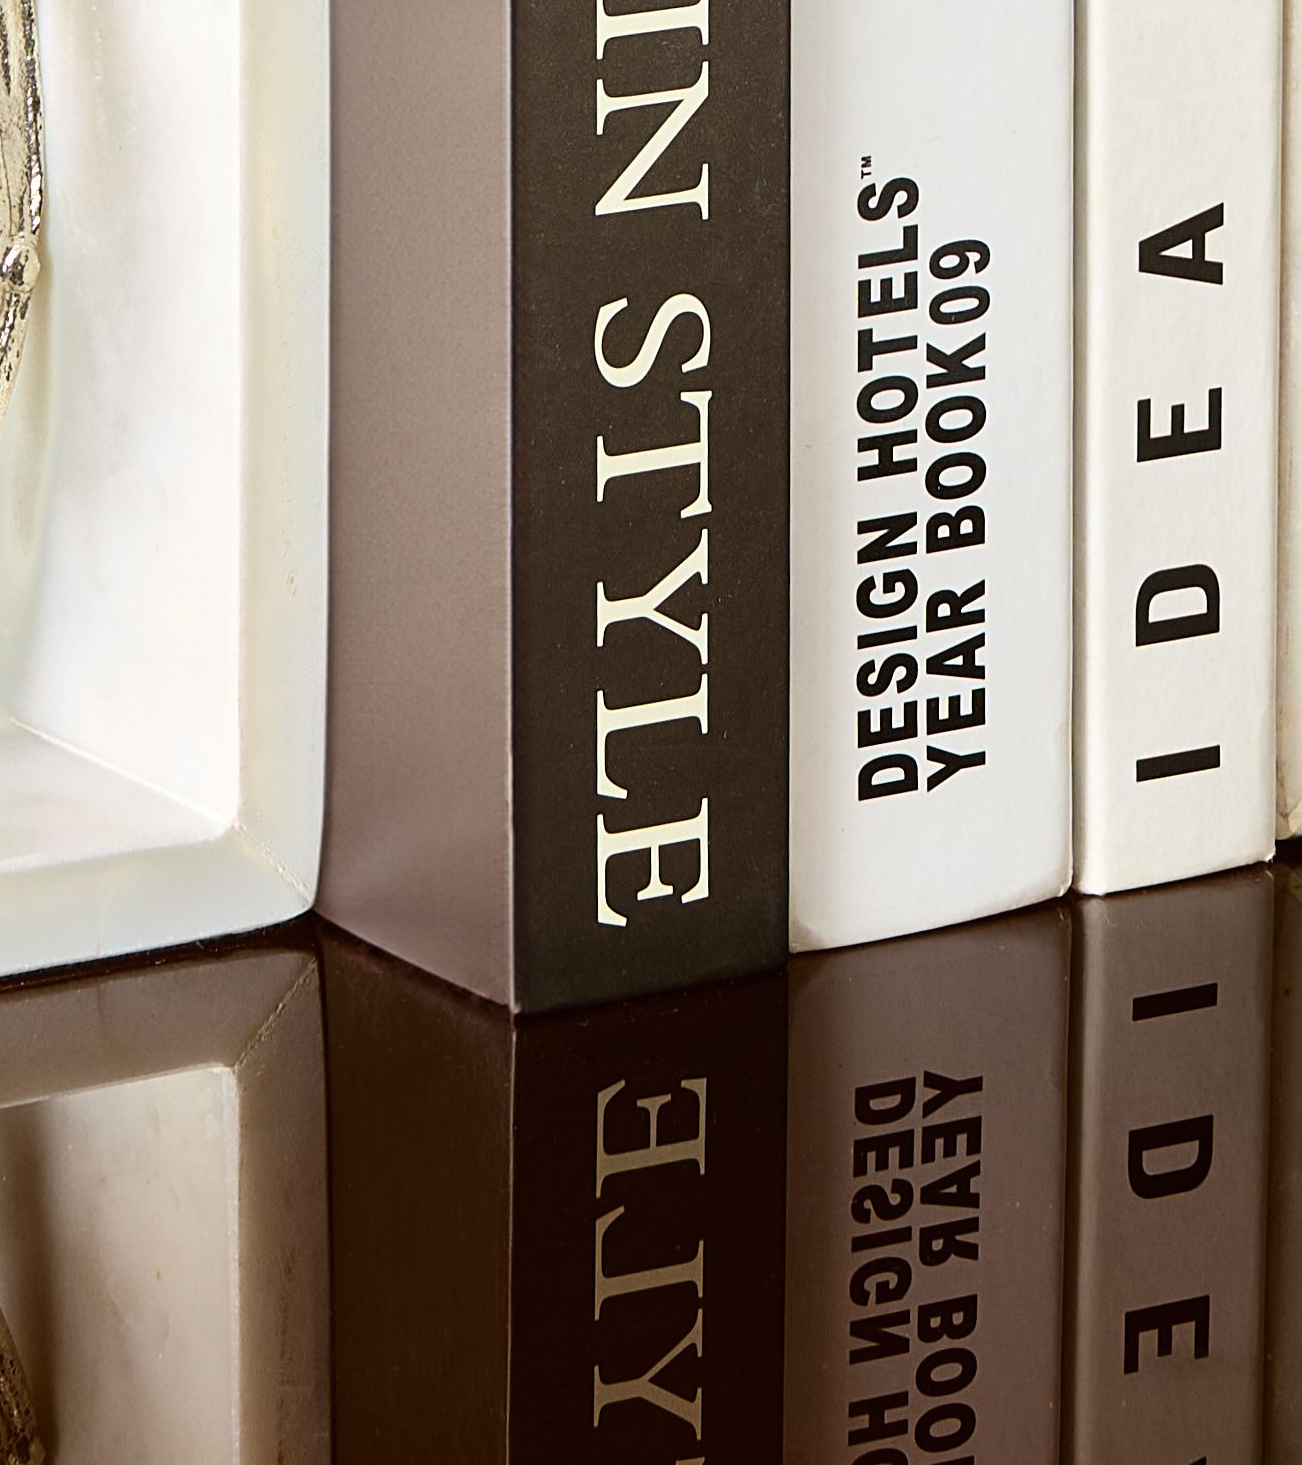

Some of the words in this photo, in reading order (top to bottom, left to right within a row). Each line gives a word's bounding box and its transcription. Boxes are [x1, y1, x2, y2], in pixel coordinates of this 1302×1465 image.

[594, 293, 713, 927] STYLE
[856, 511, 919, 802] DESIGN
[925, 579, 987, 793] YEAR
[1135, 202, 1225, 783] IDEA
